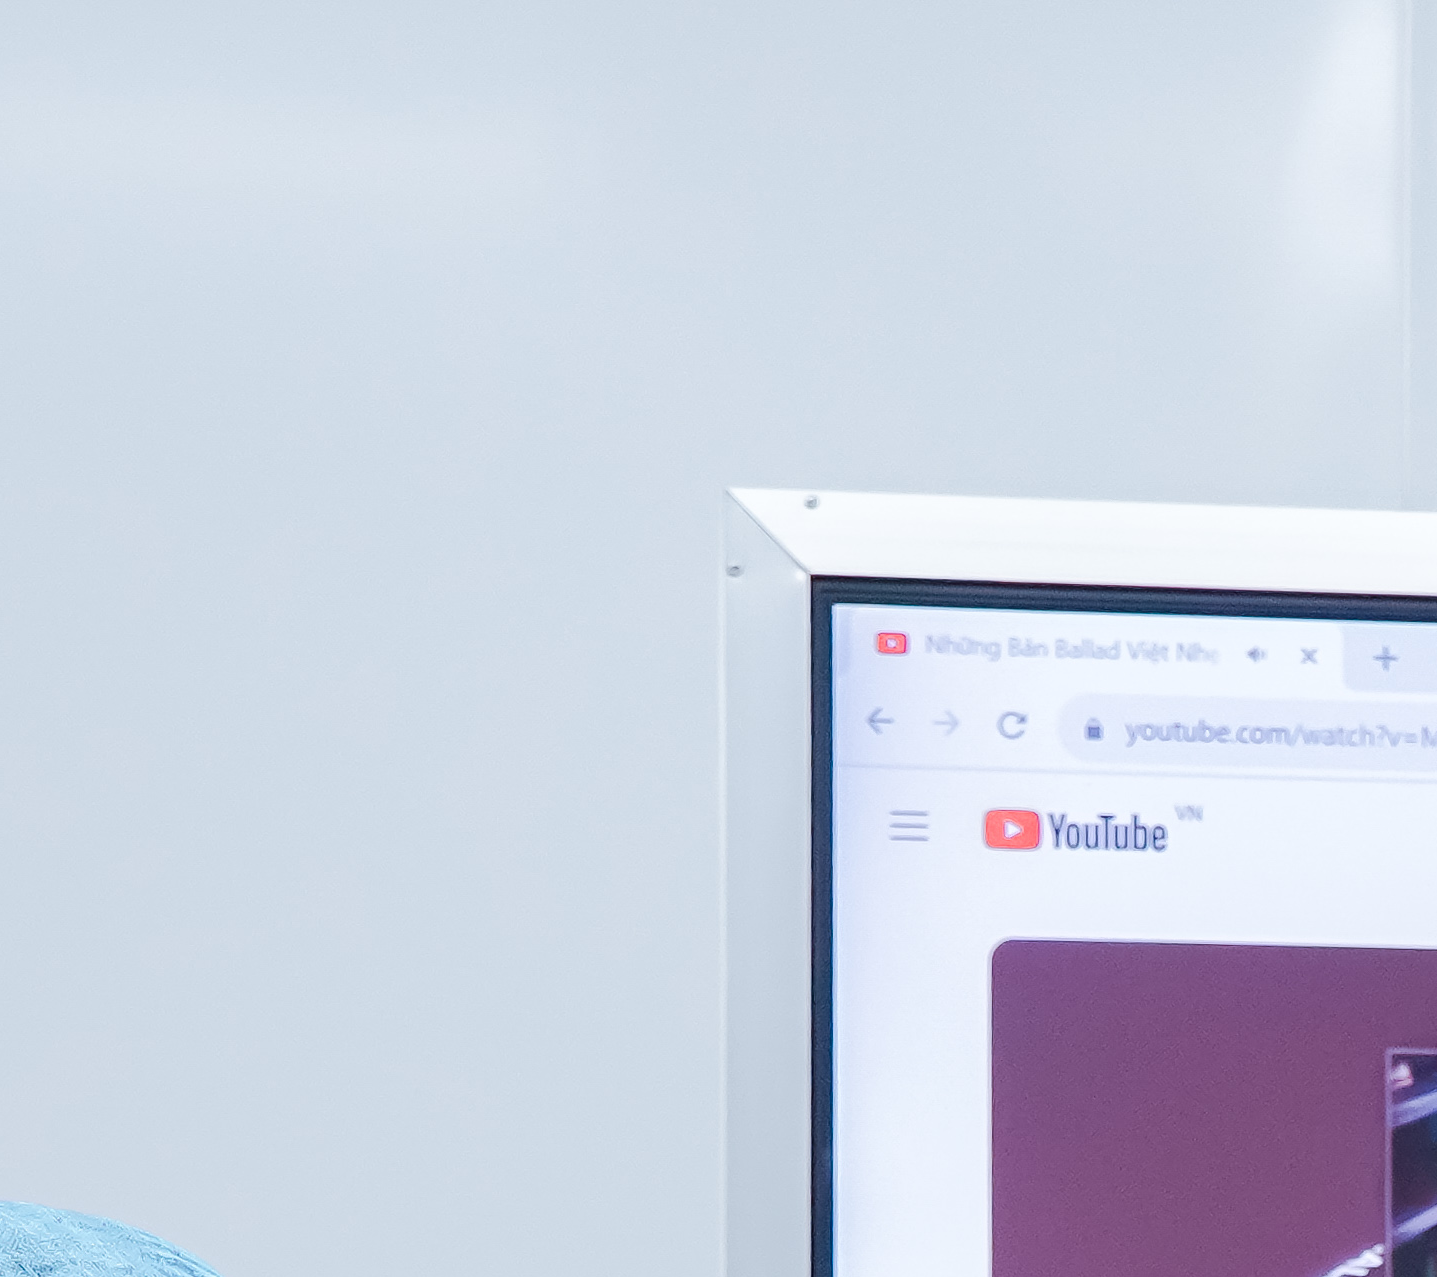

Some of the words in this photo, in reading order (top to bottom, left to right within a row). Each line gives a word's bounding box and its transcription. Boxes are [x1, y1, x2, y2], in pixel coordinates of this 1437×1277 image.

[1055, 639, 1121, 660] Ballad
[1175, 804, 1204, 822] VN
[1048, 812, 1169, 853] YouTube
